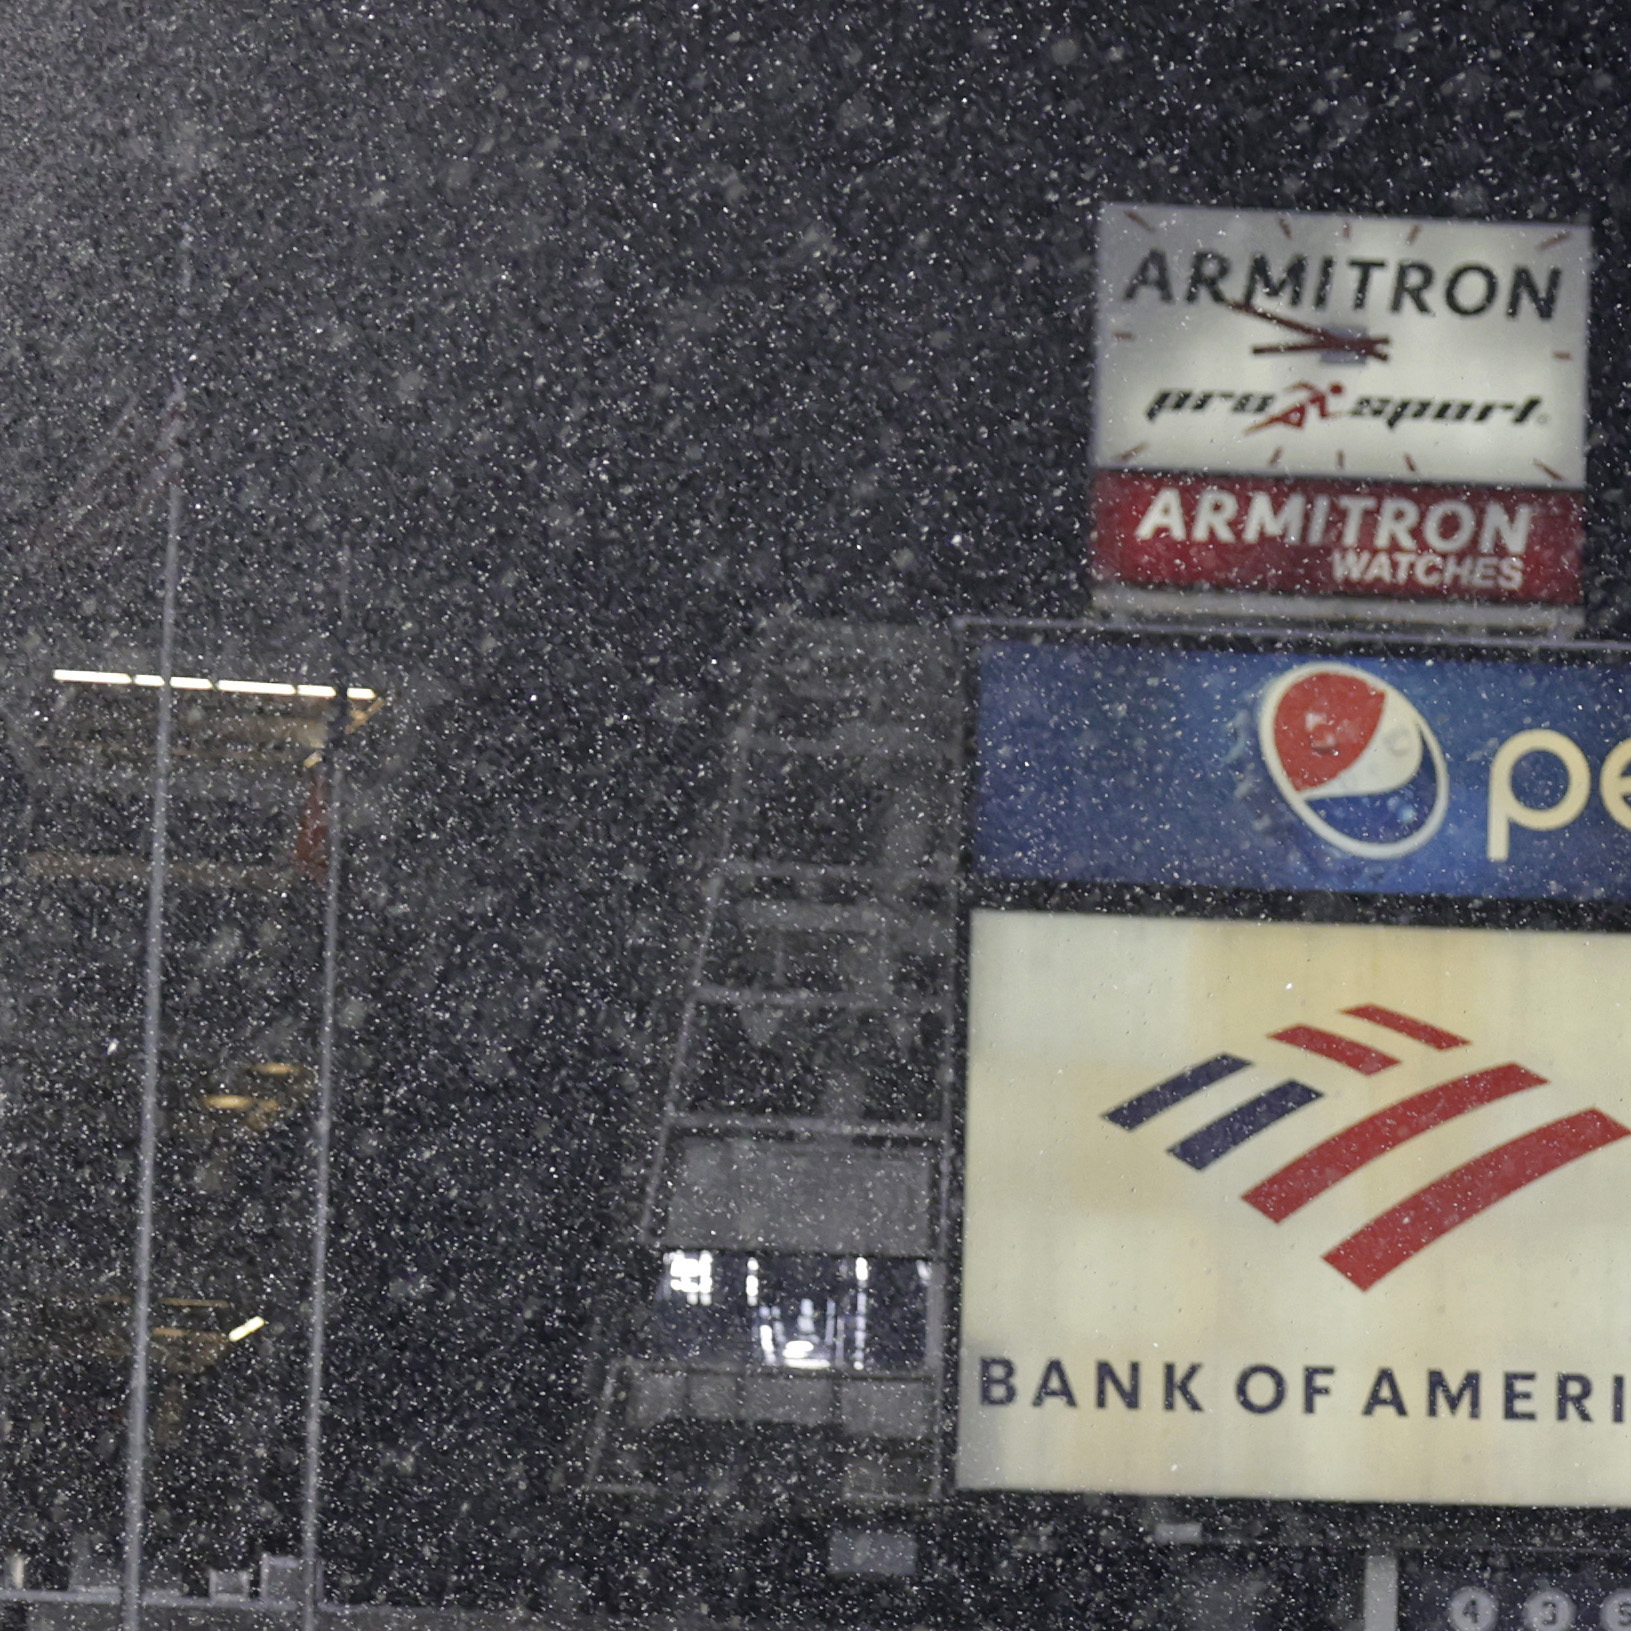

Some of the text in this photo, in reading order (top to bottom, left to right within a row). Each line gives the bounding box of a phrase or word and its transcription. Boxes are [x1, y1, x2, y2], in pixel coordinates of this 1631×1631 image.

[1124, 249, 1562, 320] ARMITRON
[1147, 389, 1542, 431] pro sport
[1135, 488, 1532, 554] ARMITRON
[1331, 550, 1524, 590] WATCHES
[979, 1356, 1204, 1413] BANK
[1235, 1364, 1336, 1413] OF
[1463, 1601, 1479, 1624] 4
[1542, 1602, 1557, 1625] 3
